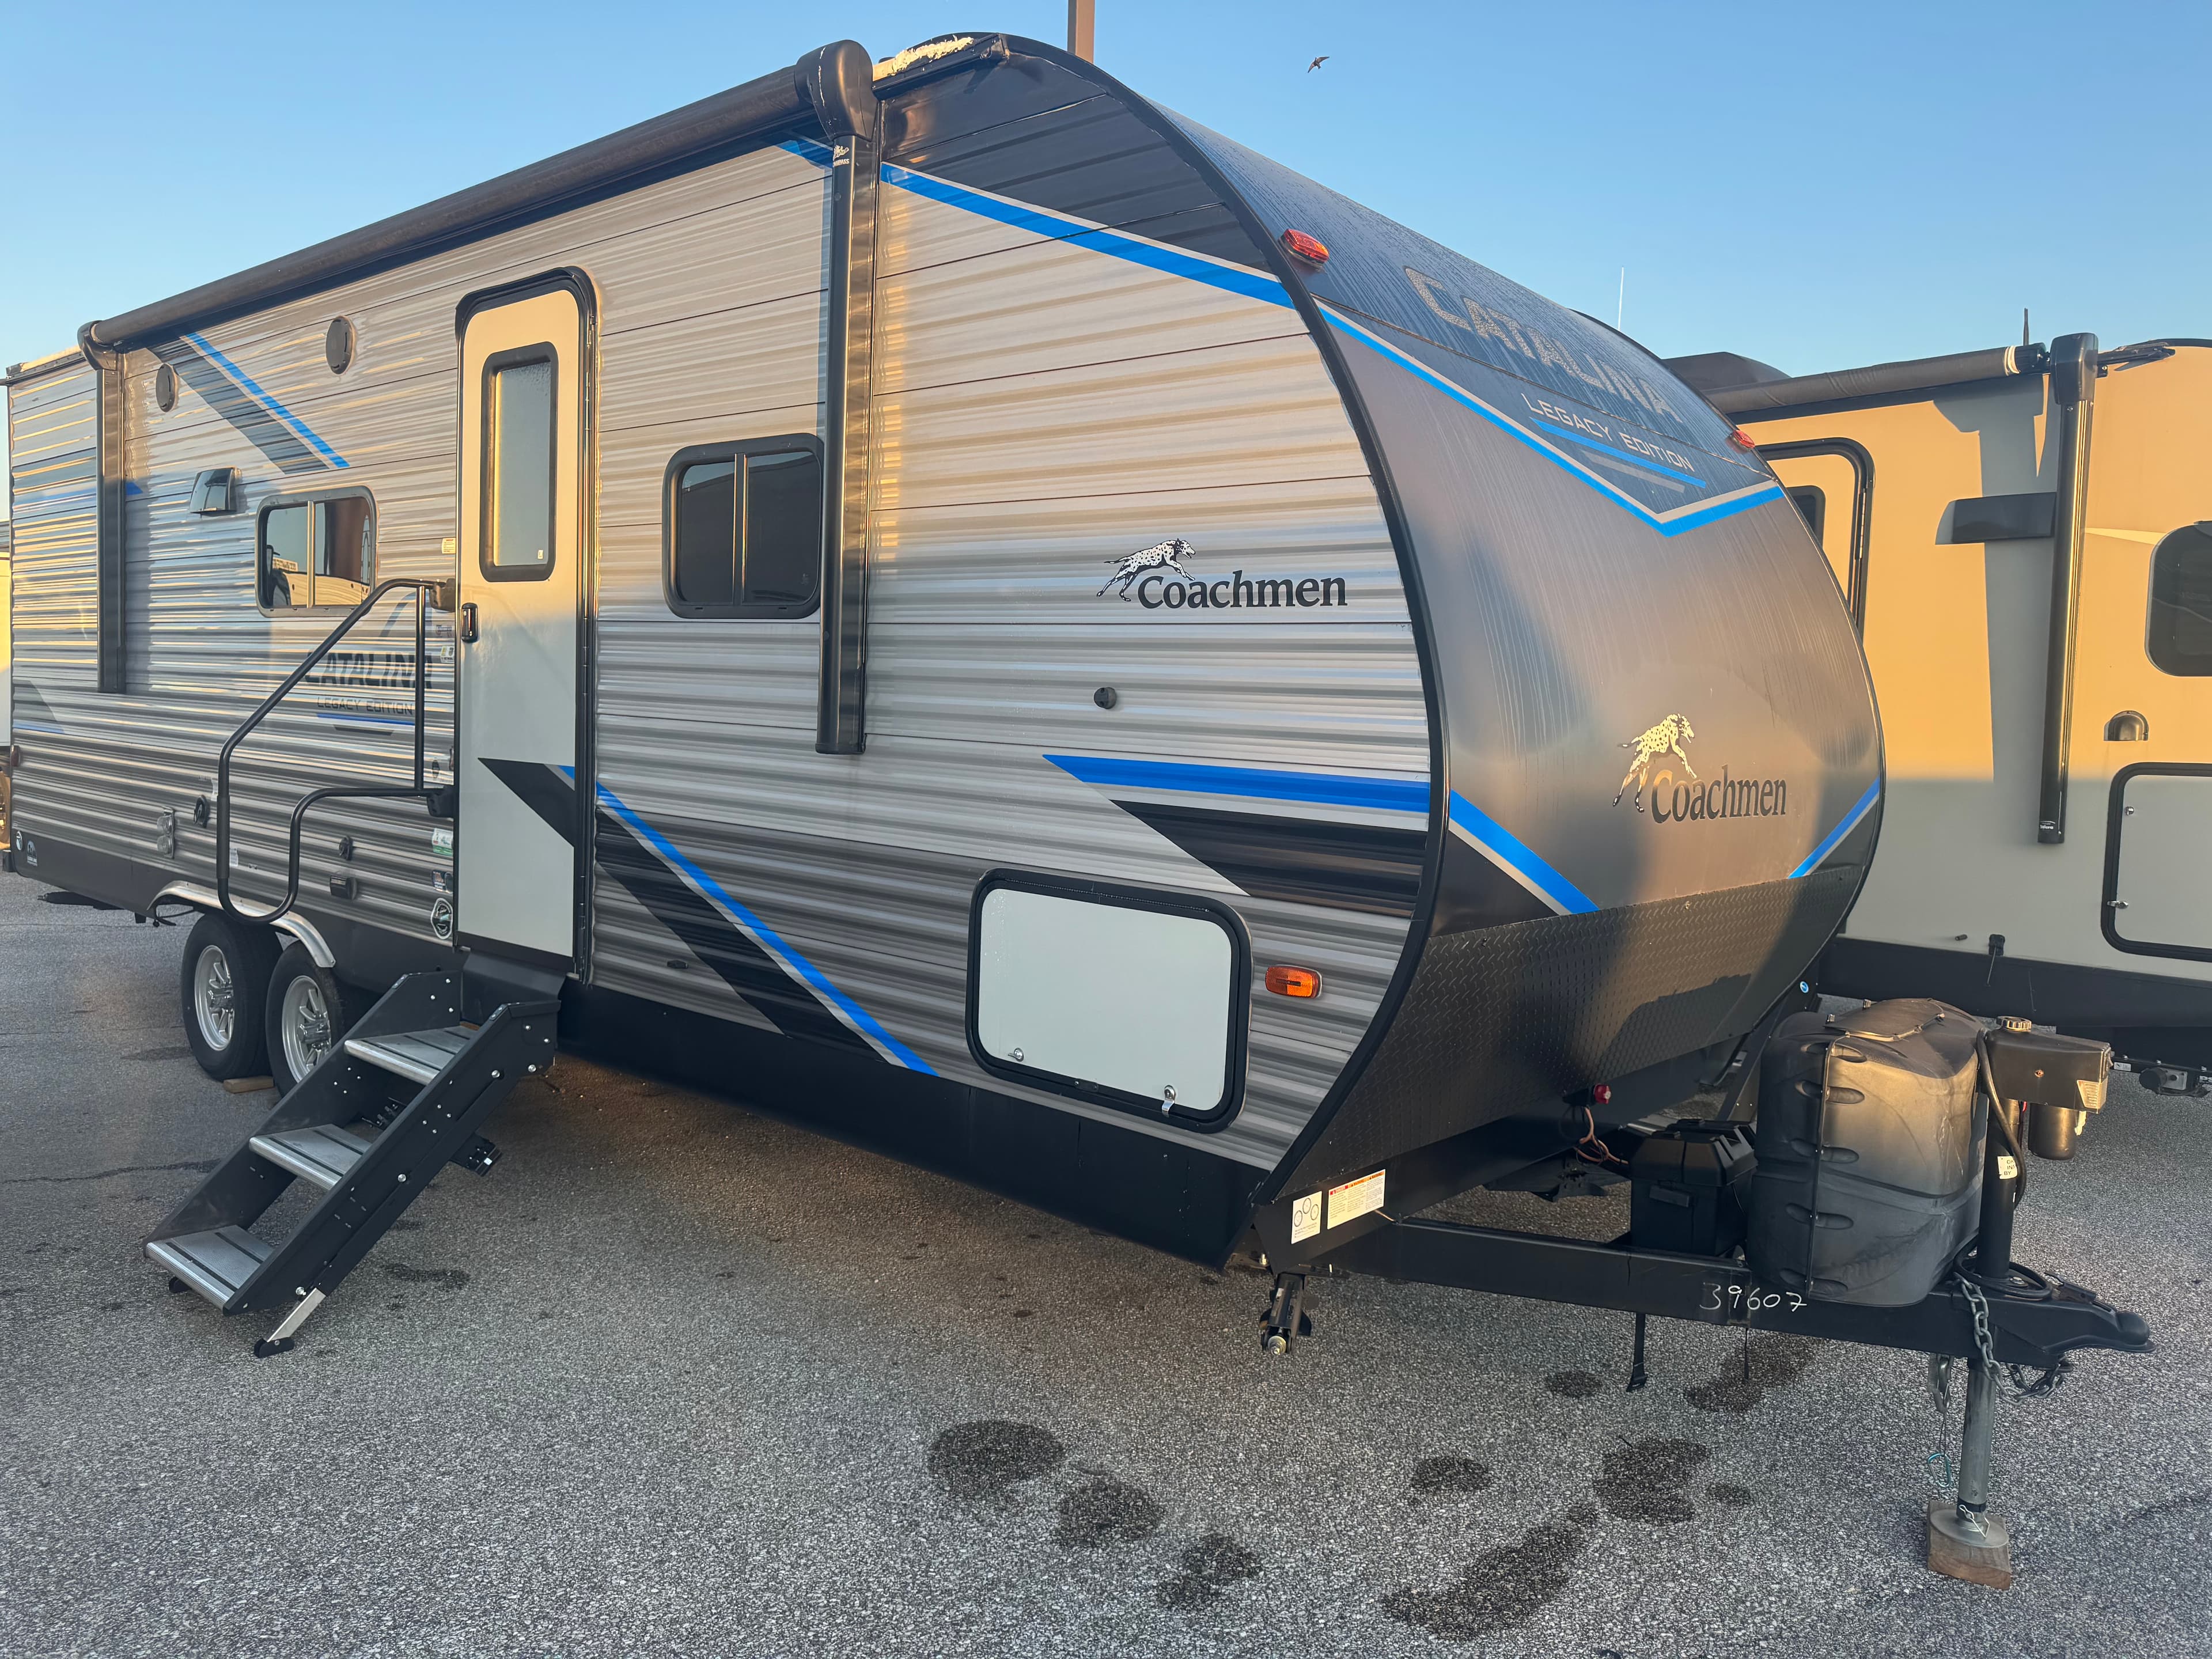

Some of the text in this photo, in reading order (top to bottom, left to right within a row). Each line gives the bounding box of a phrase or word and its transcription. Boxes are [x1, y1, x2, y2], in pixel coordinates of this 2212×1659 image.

[1404, 266, 1683, 423] CATALINA
[1521, 393, 1695, 472] LEGACY EDITION
[1138, 570, 1347, 608] Coachmen
[317, 696, 413, 715] LEGACY EDITION
[1652, 765, 1787, 823] Coachmen
[1699, 1282, 1807, 1312] 39607
